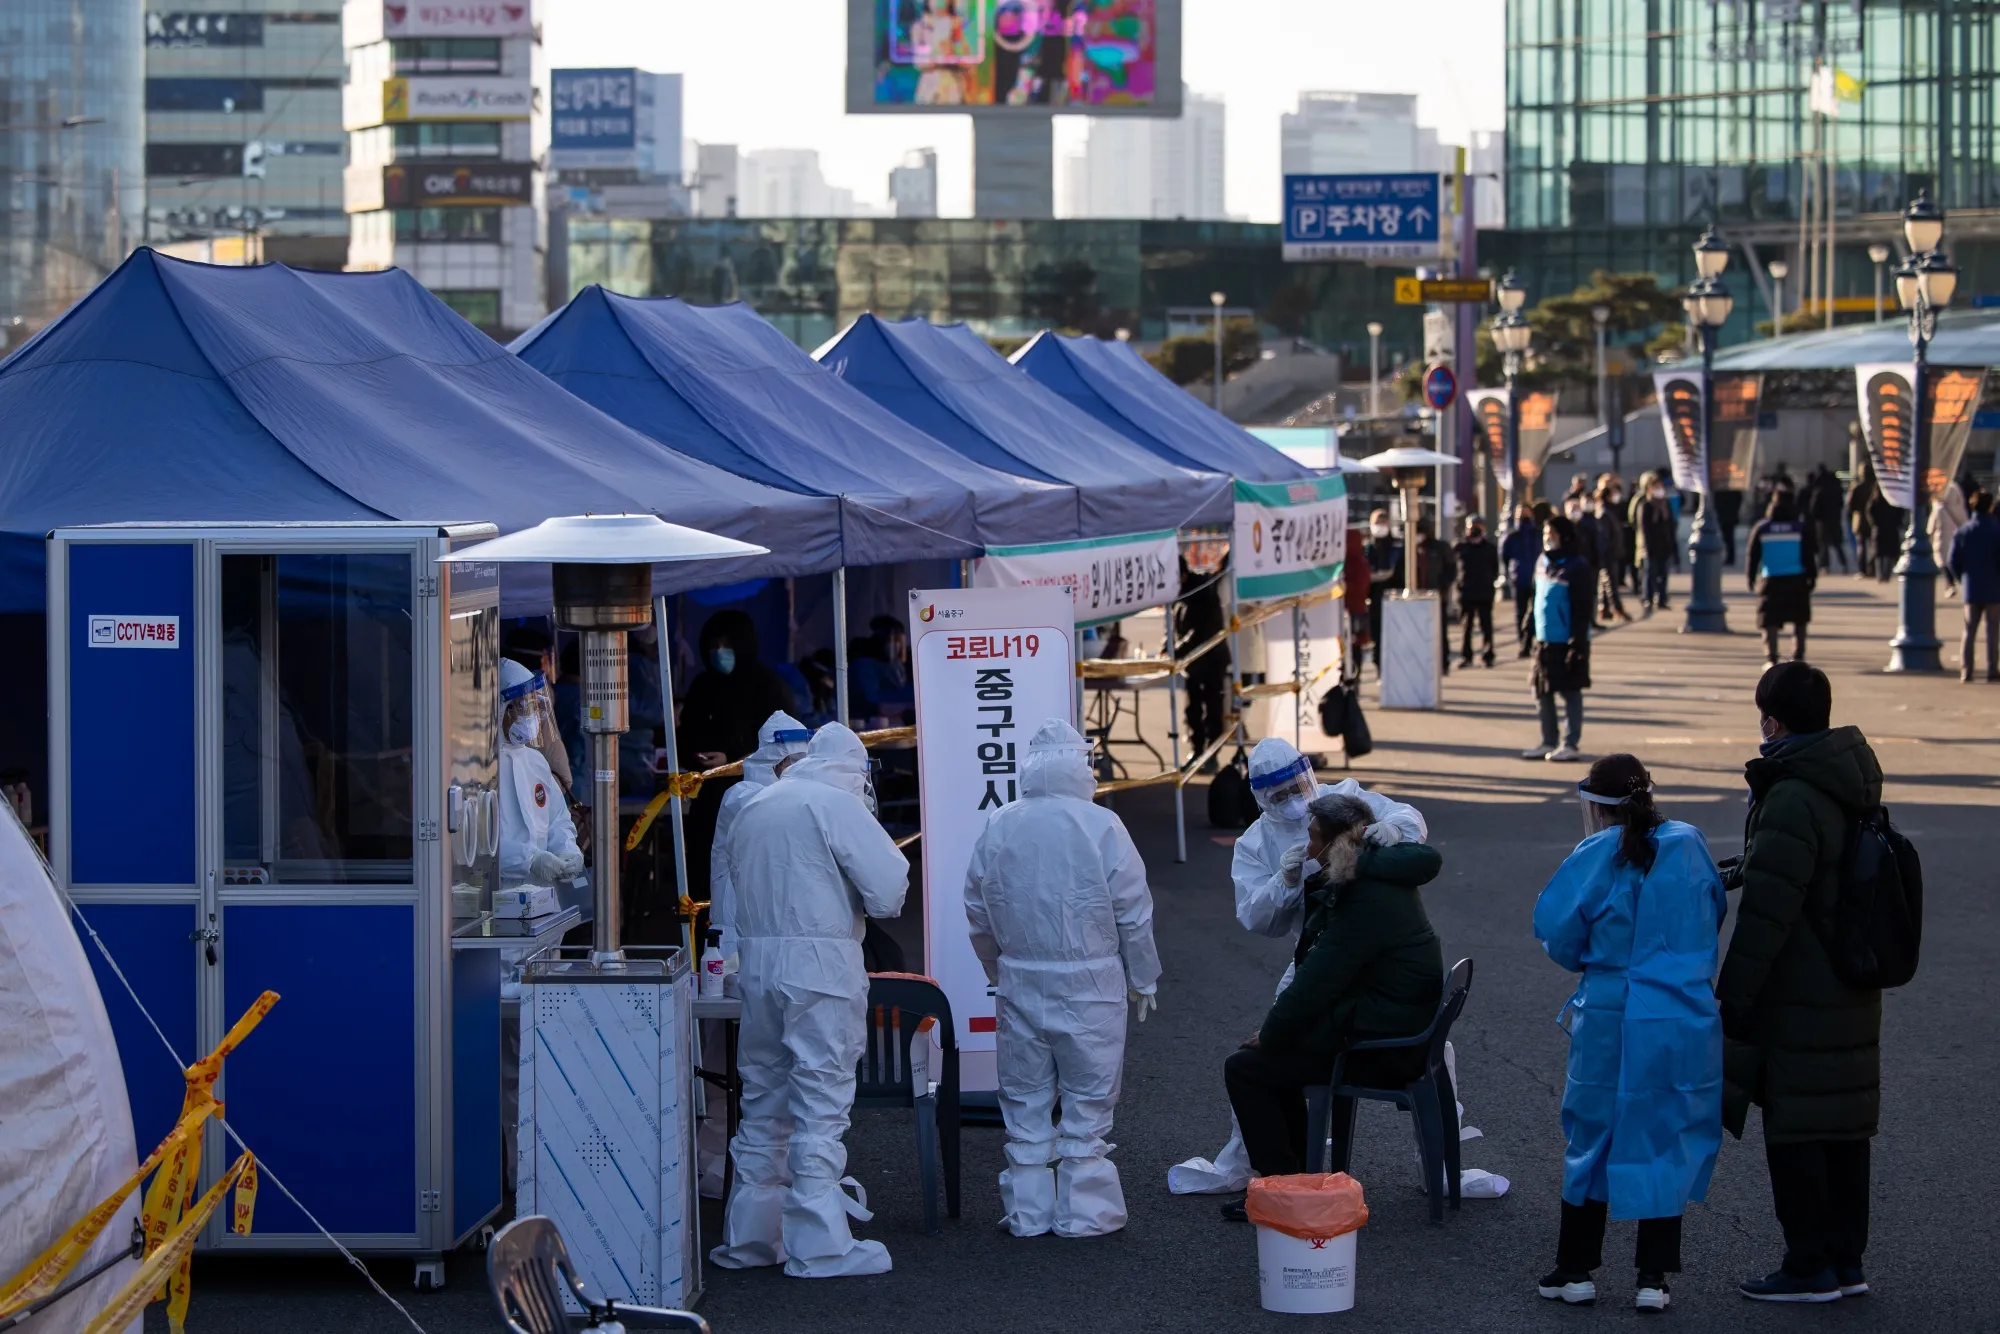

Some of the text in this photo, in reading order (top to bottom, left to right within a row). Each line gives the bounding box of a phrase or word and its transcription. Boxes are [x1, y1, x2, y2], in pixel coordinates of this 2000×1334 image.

[424, 174, 456, 194] OK
[1326, 203, 1404, 236] 주차장
[1091, 555, 1166, 609] 임시선별검사소
[937, 609, 964, 618] 서울중구
[117, 622, 176, 641] CCTV녹화중
[946, 634, 1040, 660] 코로나19
[583, 1210, 598, 1228] STEEL
